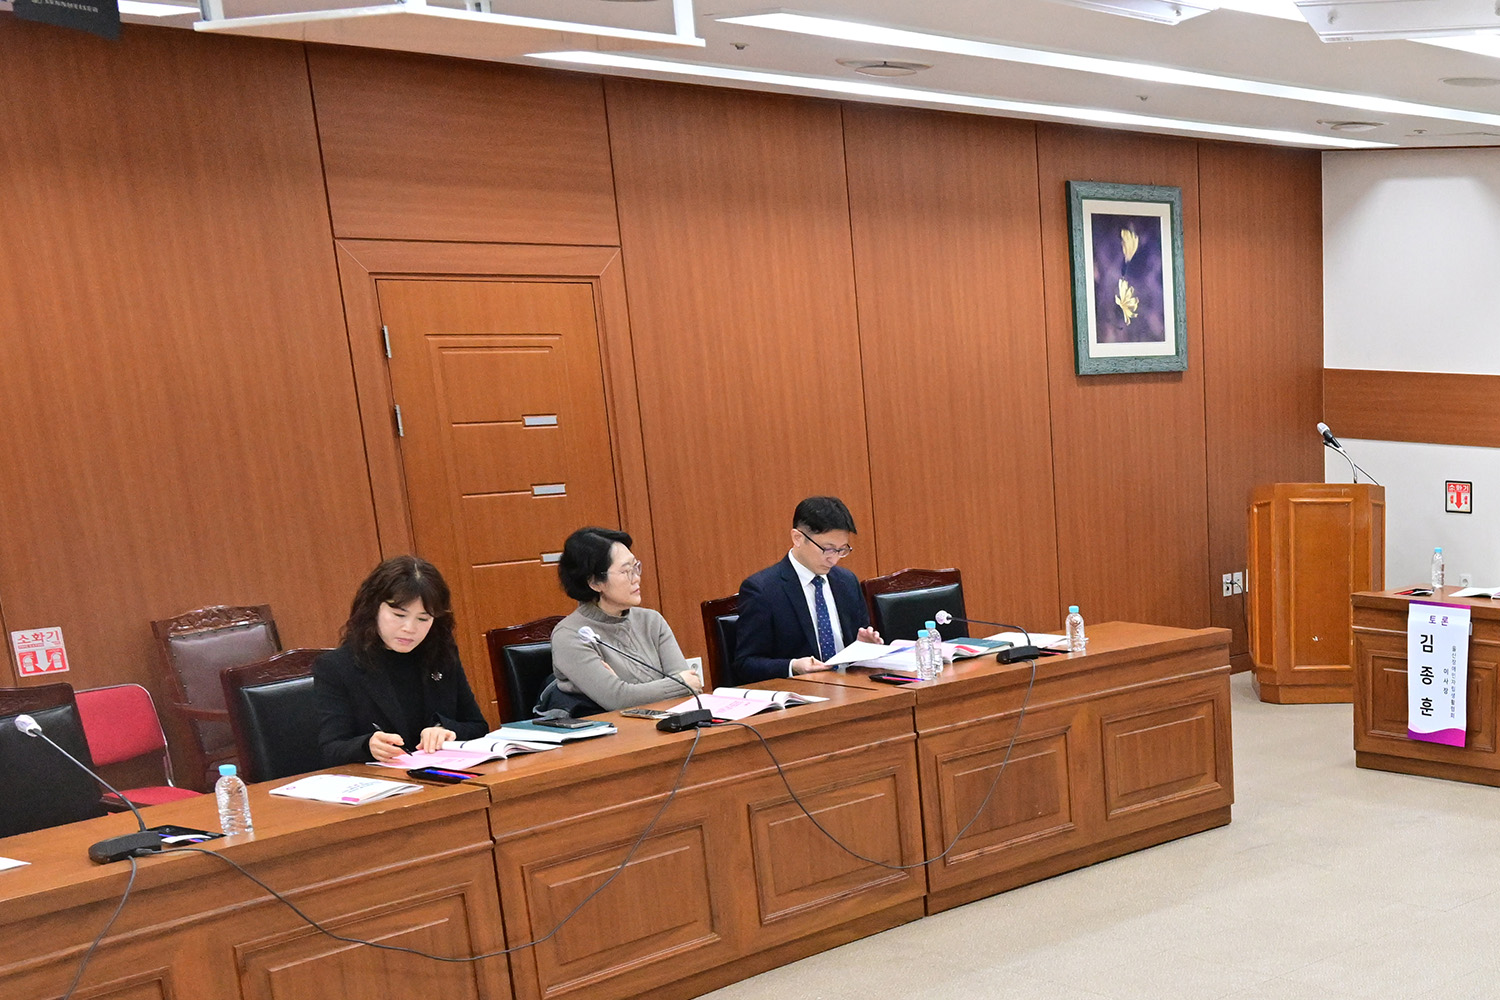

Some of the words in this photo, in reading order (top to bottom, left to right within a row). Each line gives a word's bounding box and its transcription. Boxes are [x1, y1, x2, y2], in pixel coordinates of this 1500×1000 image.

[1428, 615, 1449, 627] 토론
[17, 630, 60, 645] 소화기
[1419, 633, 1435, 717] 김종훈
